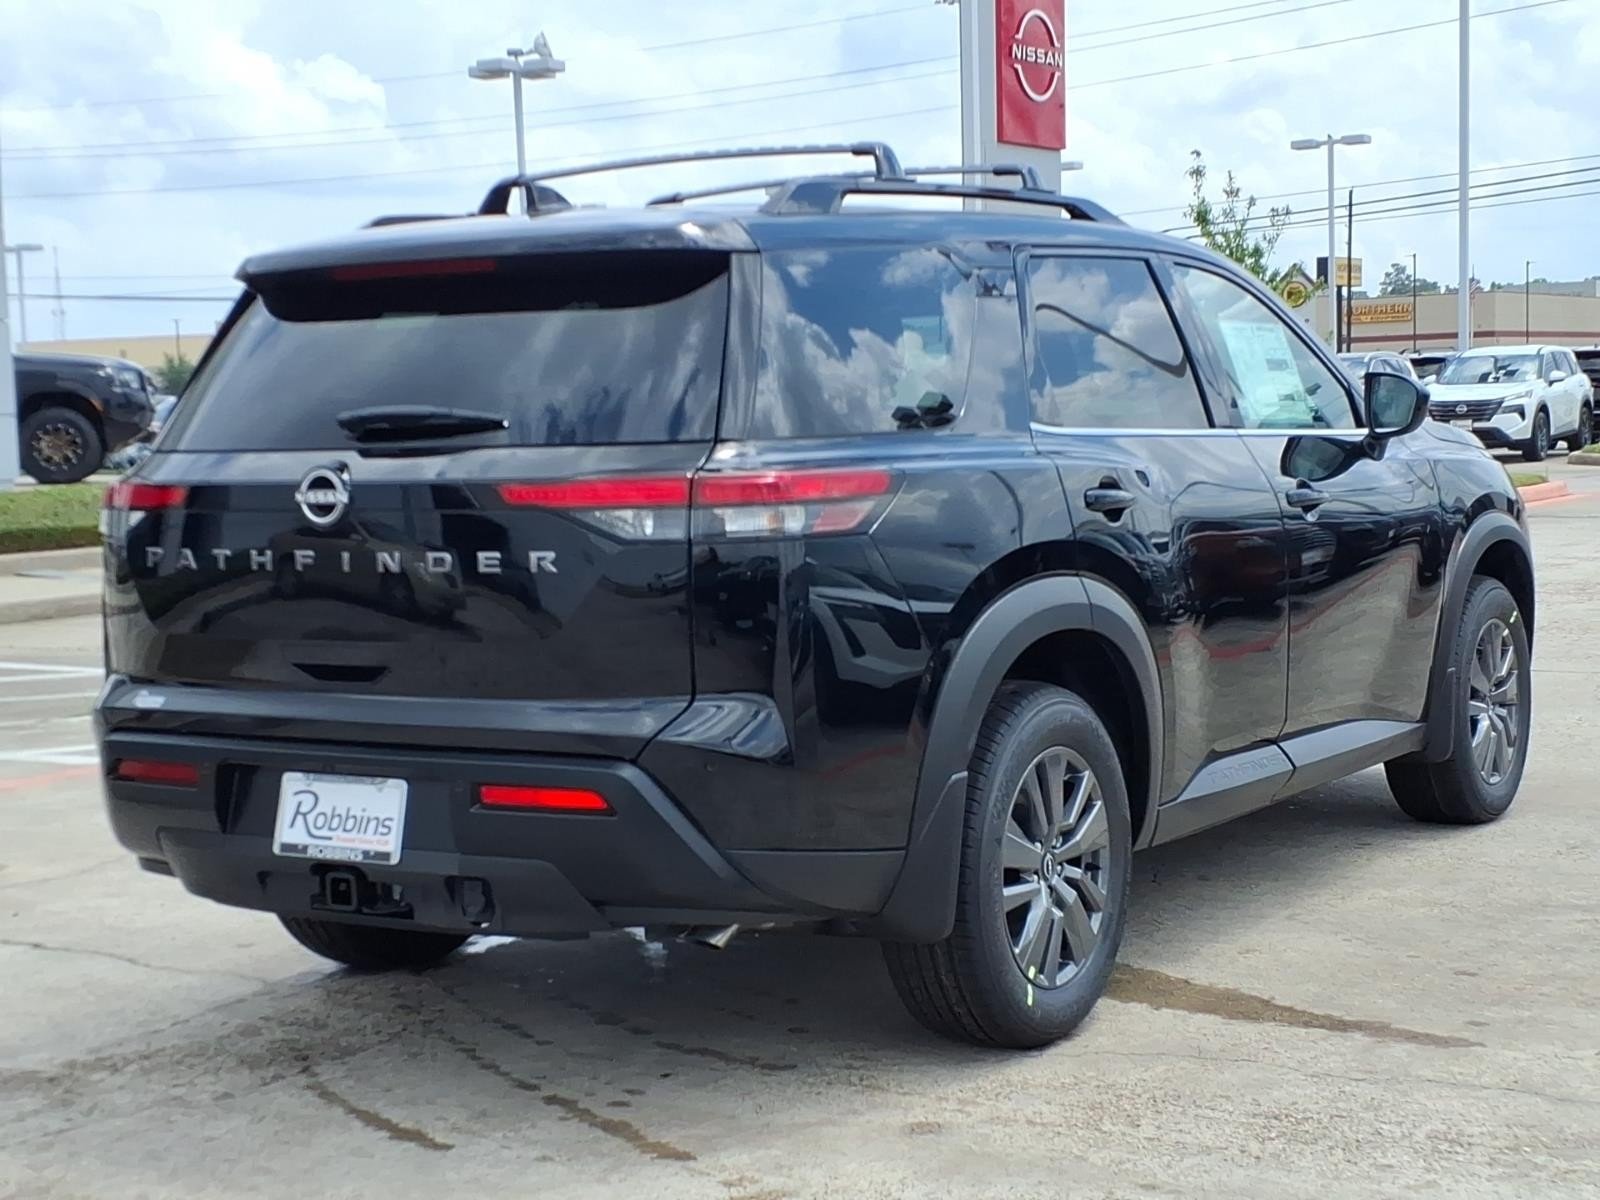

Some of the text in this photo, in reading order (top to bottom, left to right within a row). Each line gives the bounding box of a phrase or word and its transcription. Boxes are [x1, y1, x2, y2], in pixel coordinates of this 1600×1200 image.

[1012, 43, 1063, 67] NISSAN
[145, 546, 560, 574] PATHFINDER
[289, 789, 394, 840] Robbins
